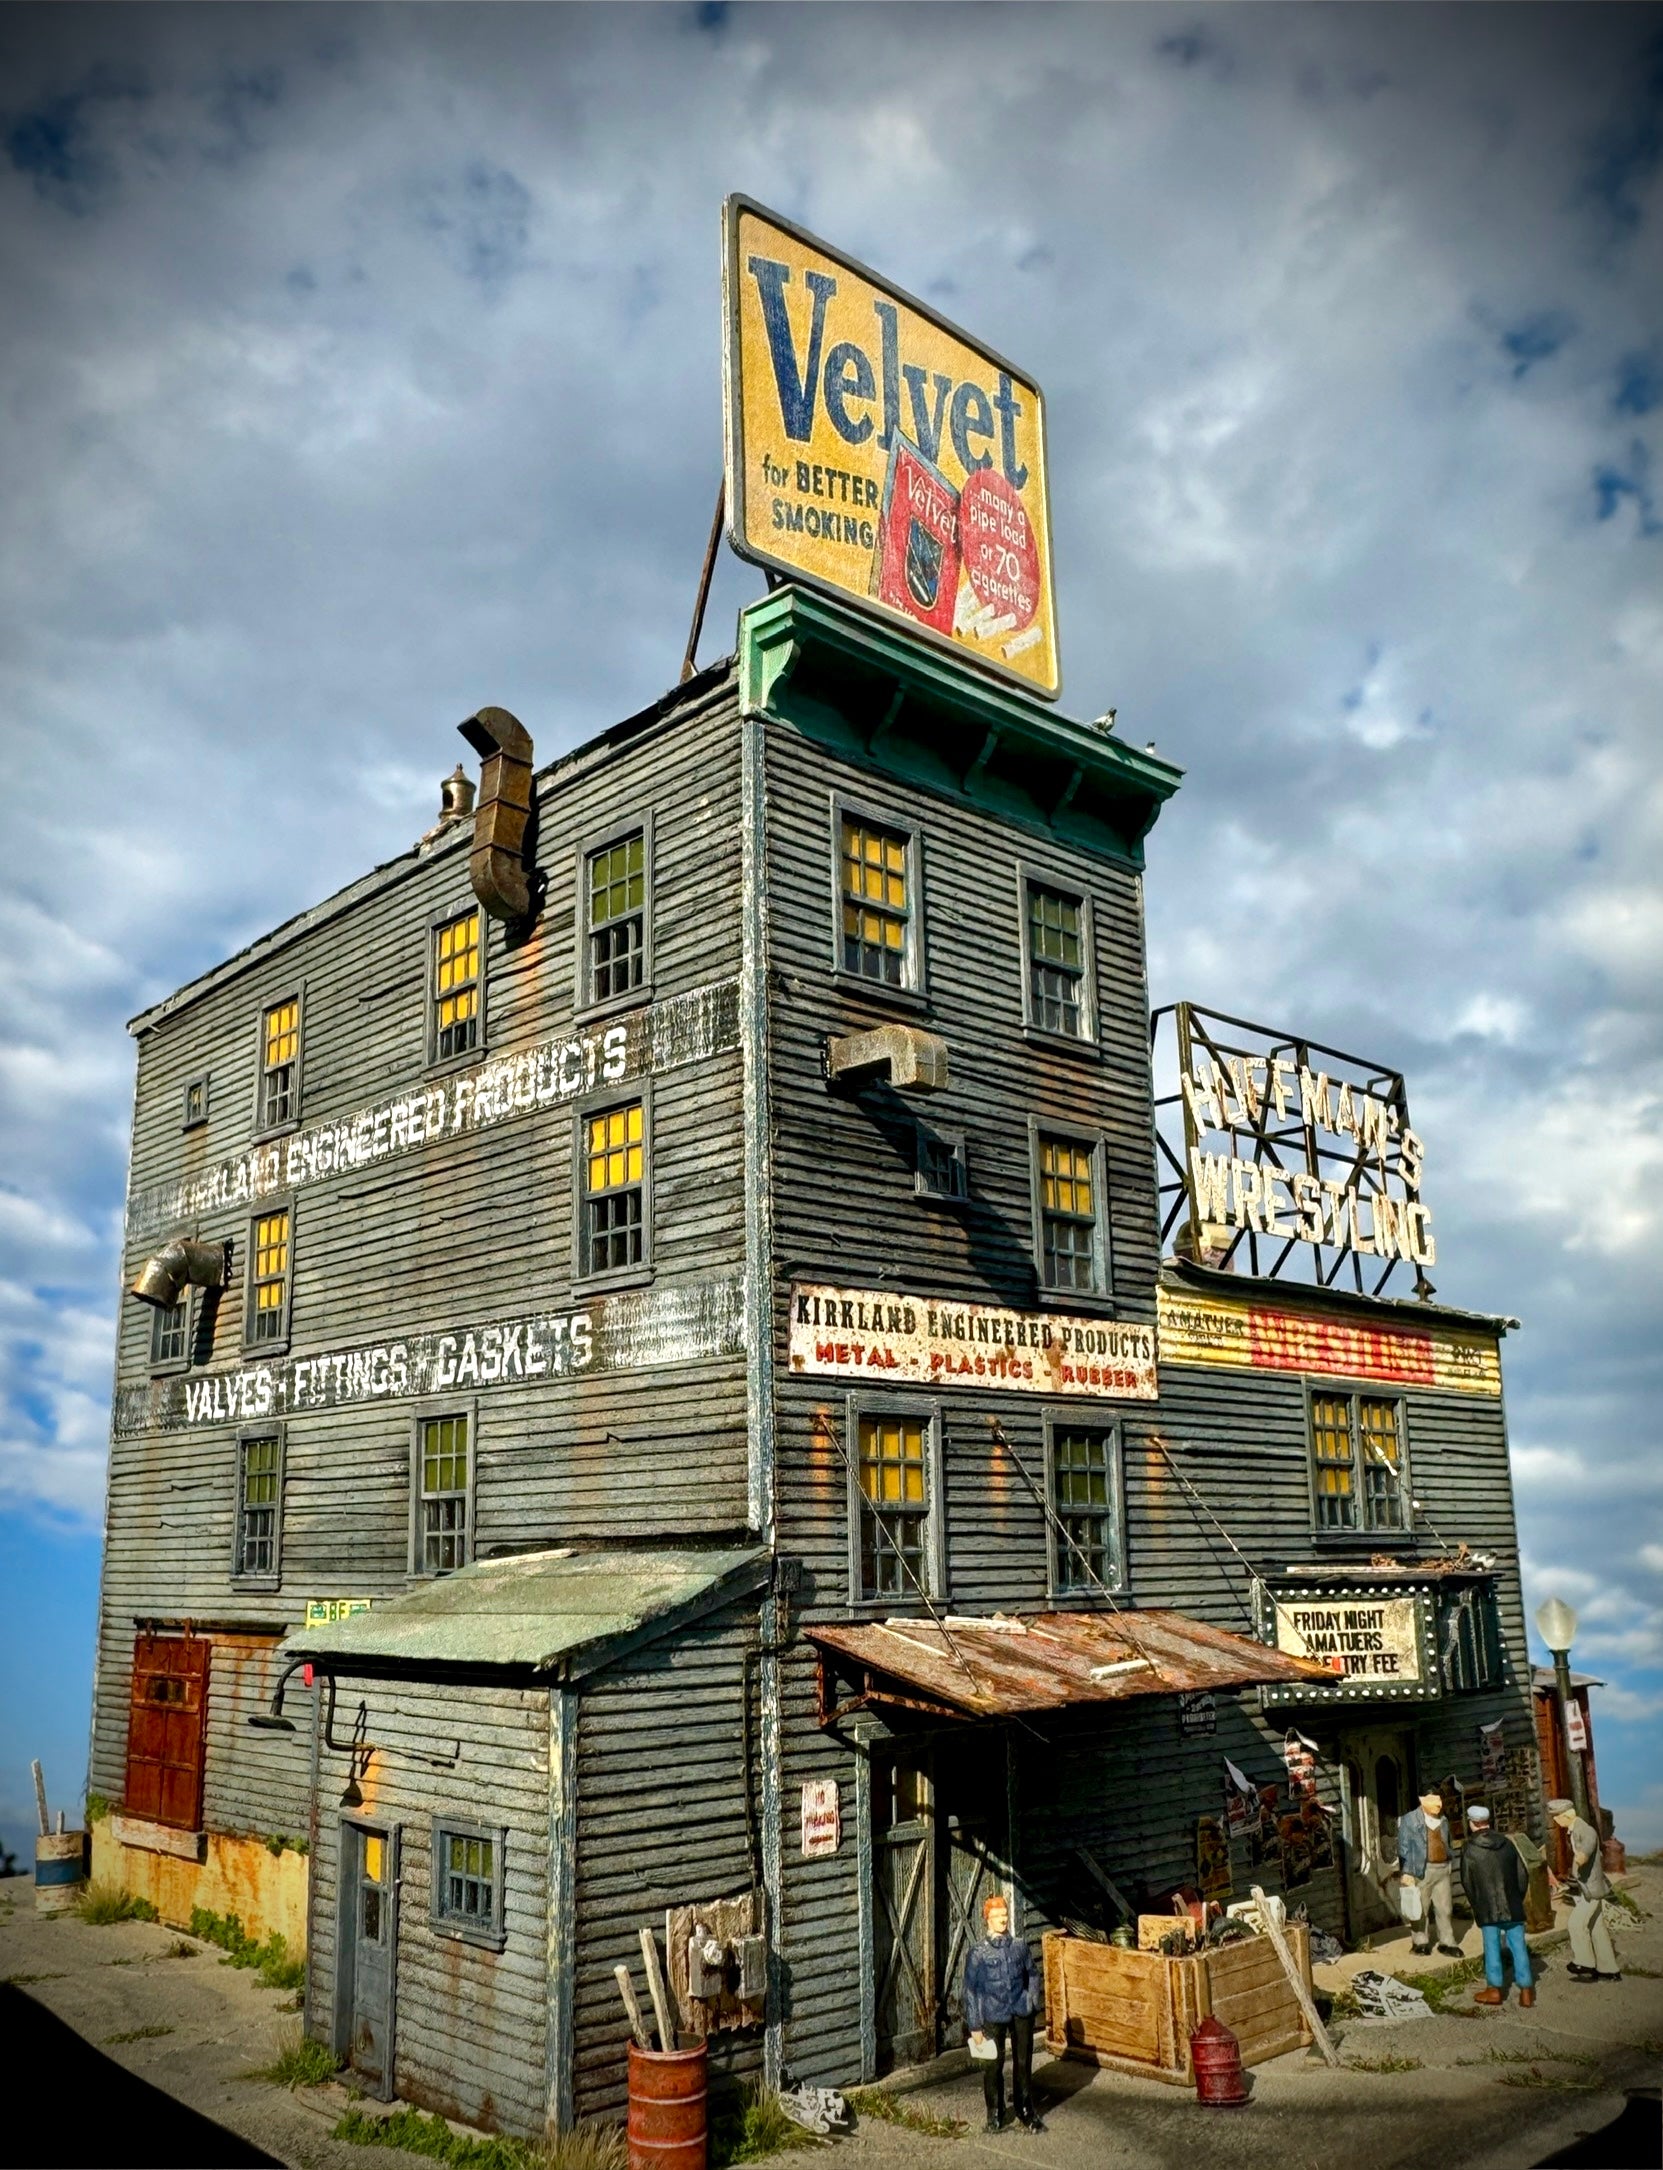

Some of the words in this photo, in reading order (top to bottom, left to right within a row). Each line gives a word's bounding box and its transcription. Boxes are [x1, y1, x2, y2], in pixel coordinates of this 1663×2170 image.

[747, 255, 1029, 490] Velvet
[762, 452, 790, 488] for
[795, 460, 879, 510] BETTER
[903, 465, 957, 544] Velvet
[771, 497, 875, 550] SMOKING
[969, 503, 998, 533] pipe
[1000, 519, 1027, 550] load
[980, 543, 994, 562] or
[995, 543, 1021, 583] 70
[970, 567, 1033, 614] cigarettes
[285, 1088, 446, 1184] ENGINEERED
[452, 1026, 627, 1128] PRODUCTS
[1189, 1146, 1437, 1267] WRESTLING
[796, 1294, 917, 1335] KIRKLAND
[927, 1310, 1051, 1350] ENGINEERED
[1061, 1326, 1150, 1360] PRODUCTS
[184, 1366, 273, 1423] VALVES
[294, 1343, 409, 1406] FITTINGS
[437, 1313, 593, 1385] GASKETS
[815, 1341, 900, 1369] METAL
[929, 1351, 1034, 1379] PLASTICS
[1061, 1364, 1138, 1388] RUBBER
[1293, 1609, 1342, 1632] FRIDAY
[1344, 1609, 1385, 1630] NIGHT
[1306, 1631, 1384, 1653] AMATUERS
[1323, 1654, 1368, 1675] ETRY
[1373, 1653, 1400, 1674] FEE
